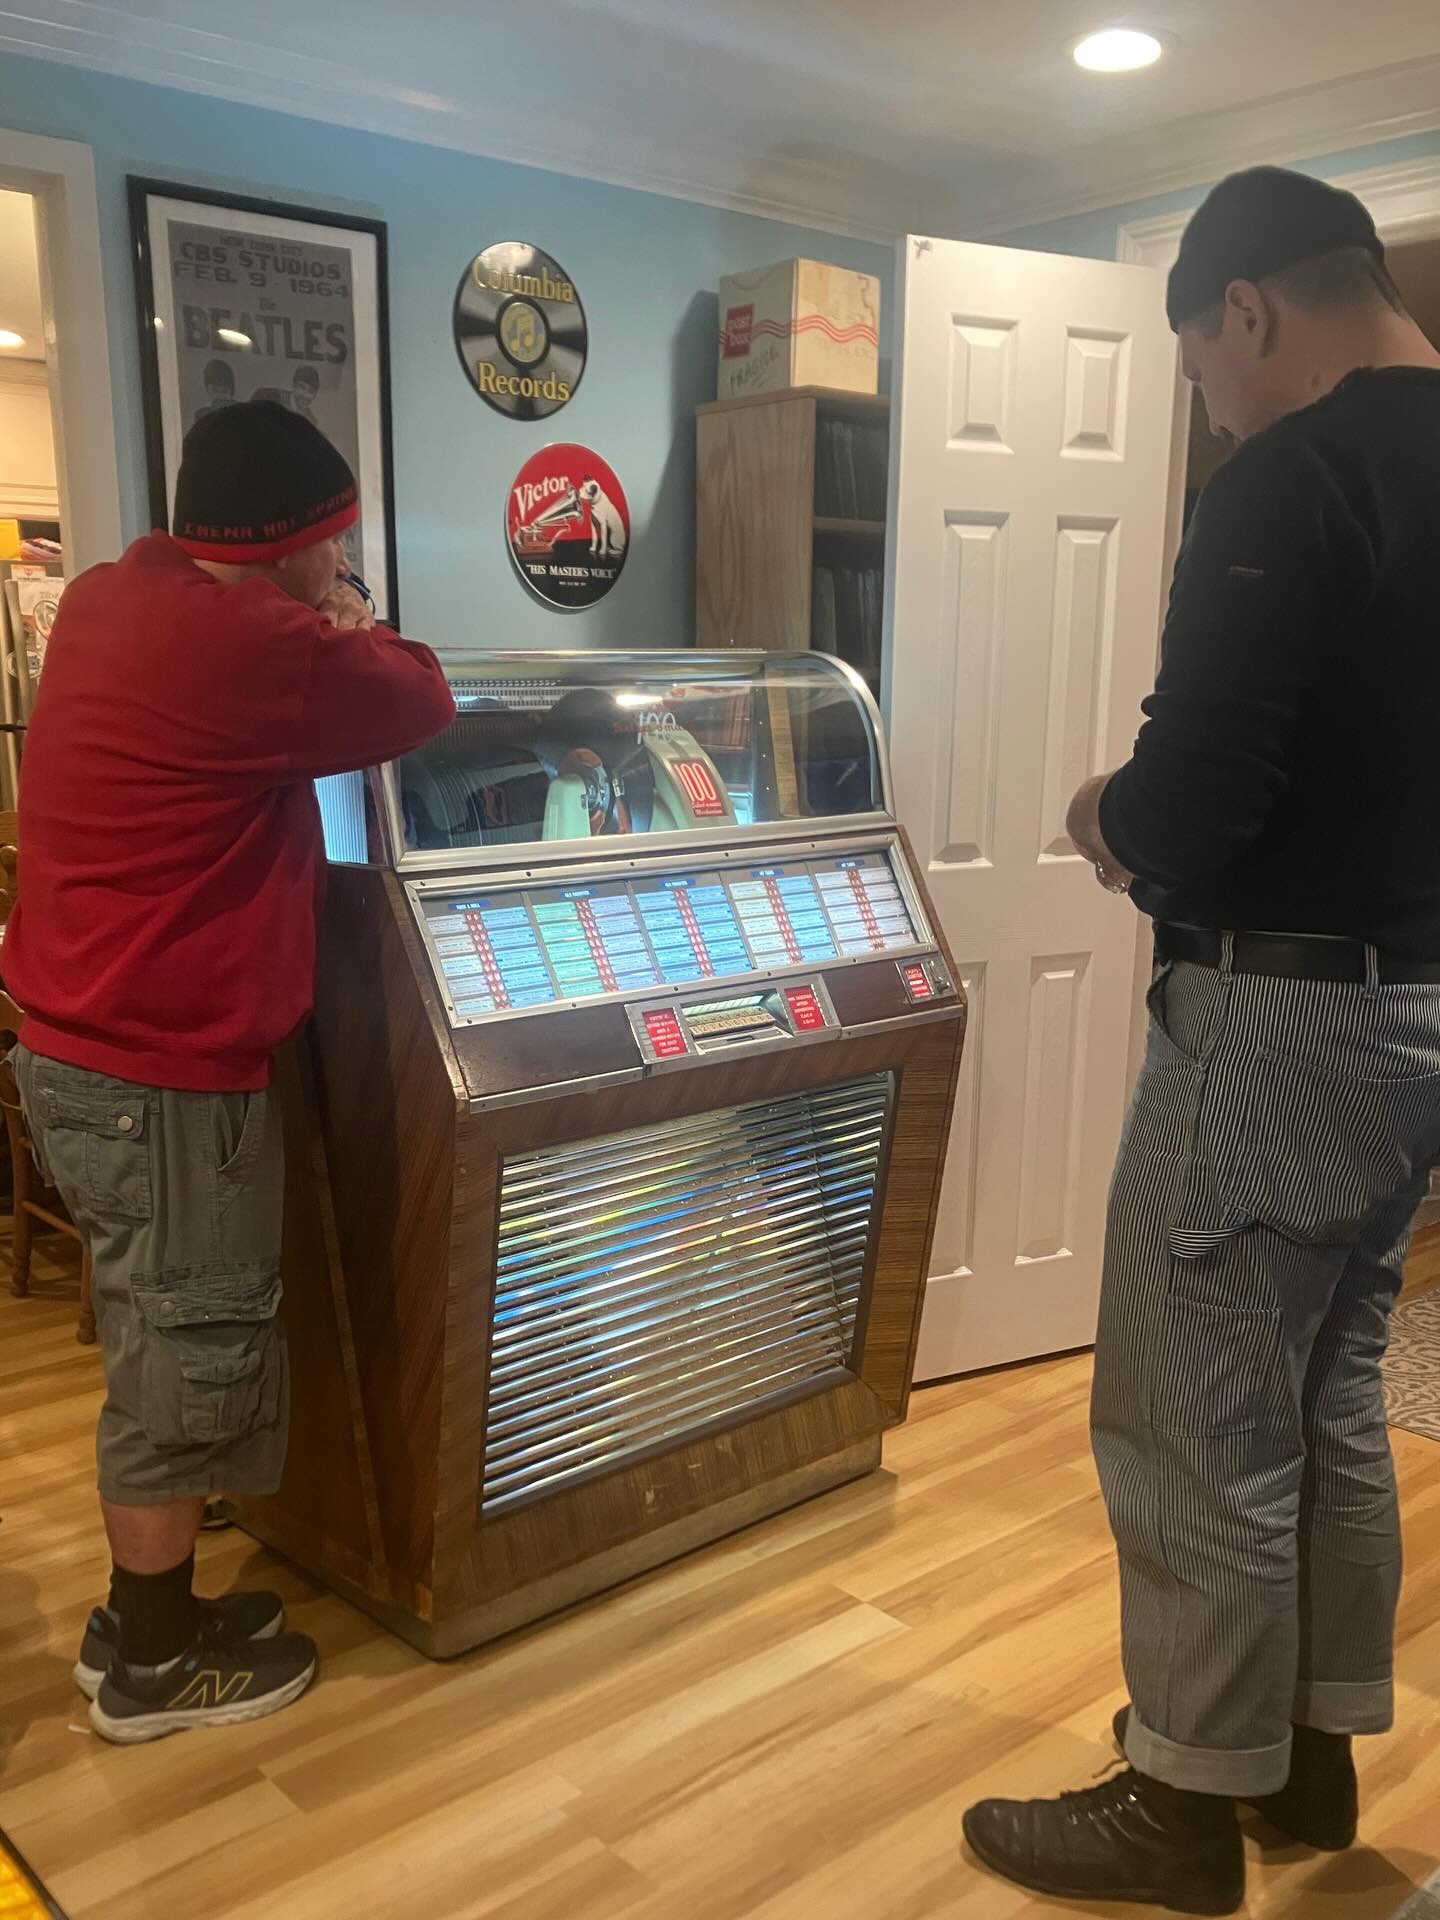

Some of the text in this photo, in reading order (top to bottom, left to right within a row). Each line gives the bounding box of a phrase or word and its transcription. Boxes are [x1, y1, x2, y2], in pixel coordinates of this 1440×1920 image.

[181, 242, 342, 280] CBS STUDIOS
[472, 254, 574, 305] Columbia
[289, 278, 349, 298] 1964
[182, 303, 348, 364] BEATLES
[479, 361, 570, 401] Records
[513, 475, 569, 522] Victor
[264, 516, 297, 538] HOT
[673, 762, 717, 803] 100
